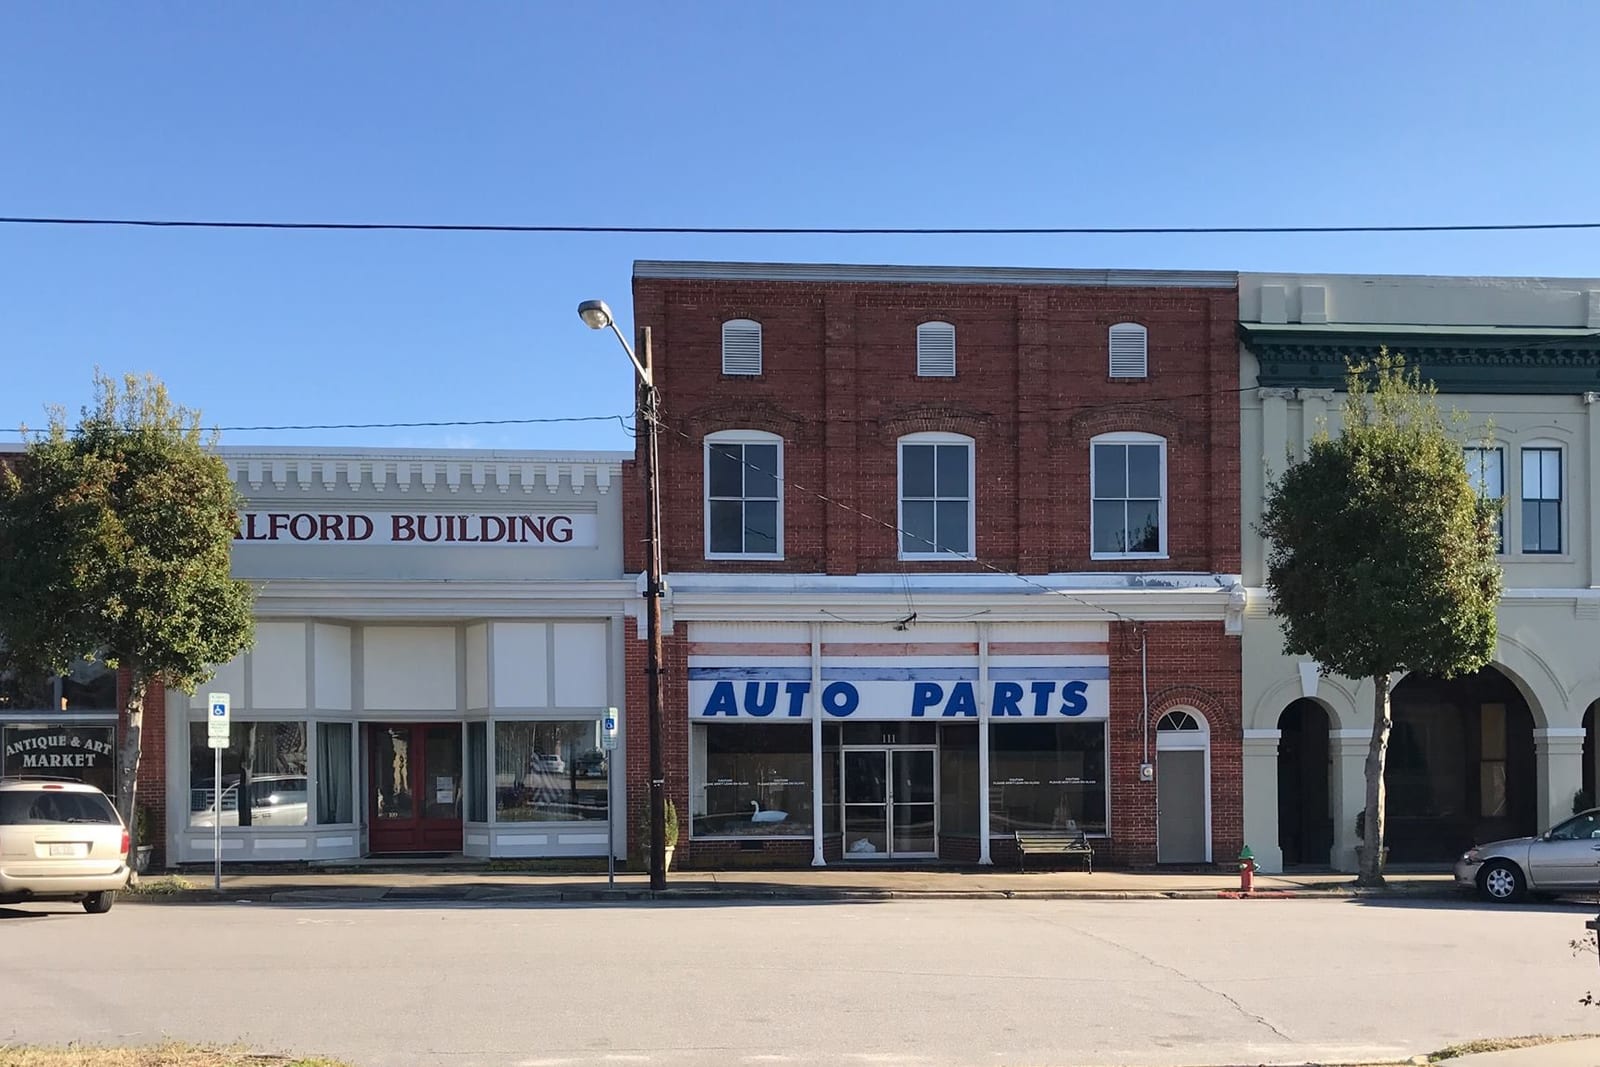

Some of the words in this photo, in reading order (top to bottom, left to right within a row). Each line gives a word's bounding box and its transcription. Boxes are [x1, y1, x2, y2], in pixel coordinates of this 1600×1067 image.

[234, 513, 374, 541] LFORD
[390, 514, 573, 543] BUILDING
[702, 681, 859, 717] AUTO
[911, 681, 1089, 717] PARTS
[6, 735, 67, 757] ANTIQUE
[70, 736, 81, 748] &
[84, 739, 112, 755] ART
[23, 753, 96, 768] MARKET
